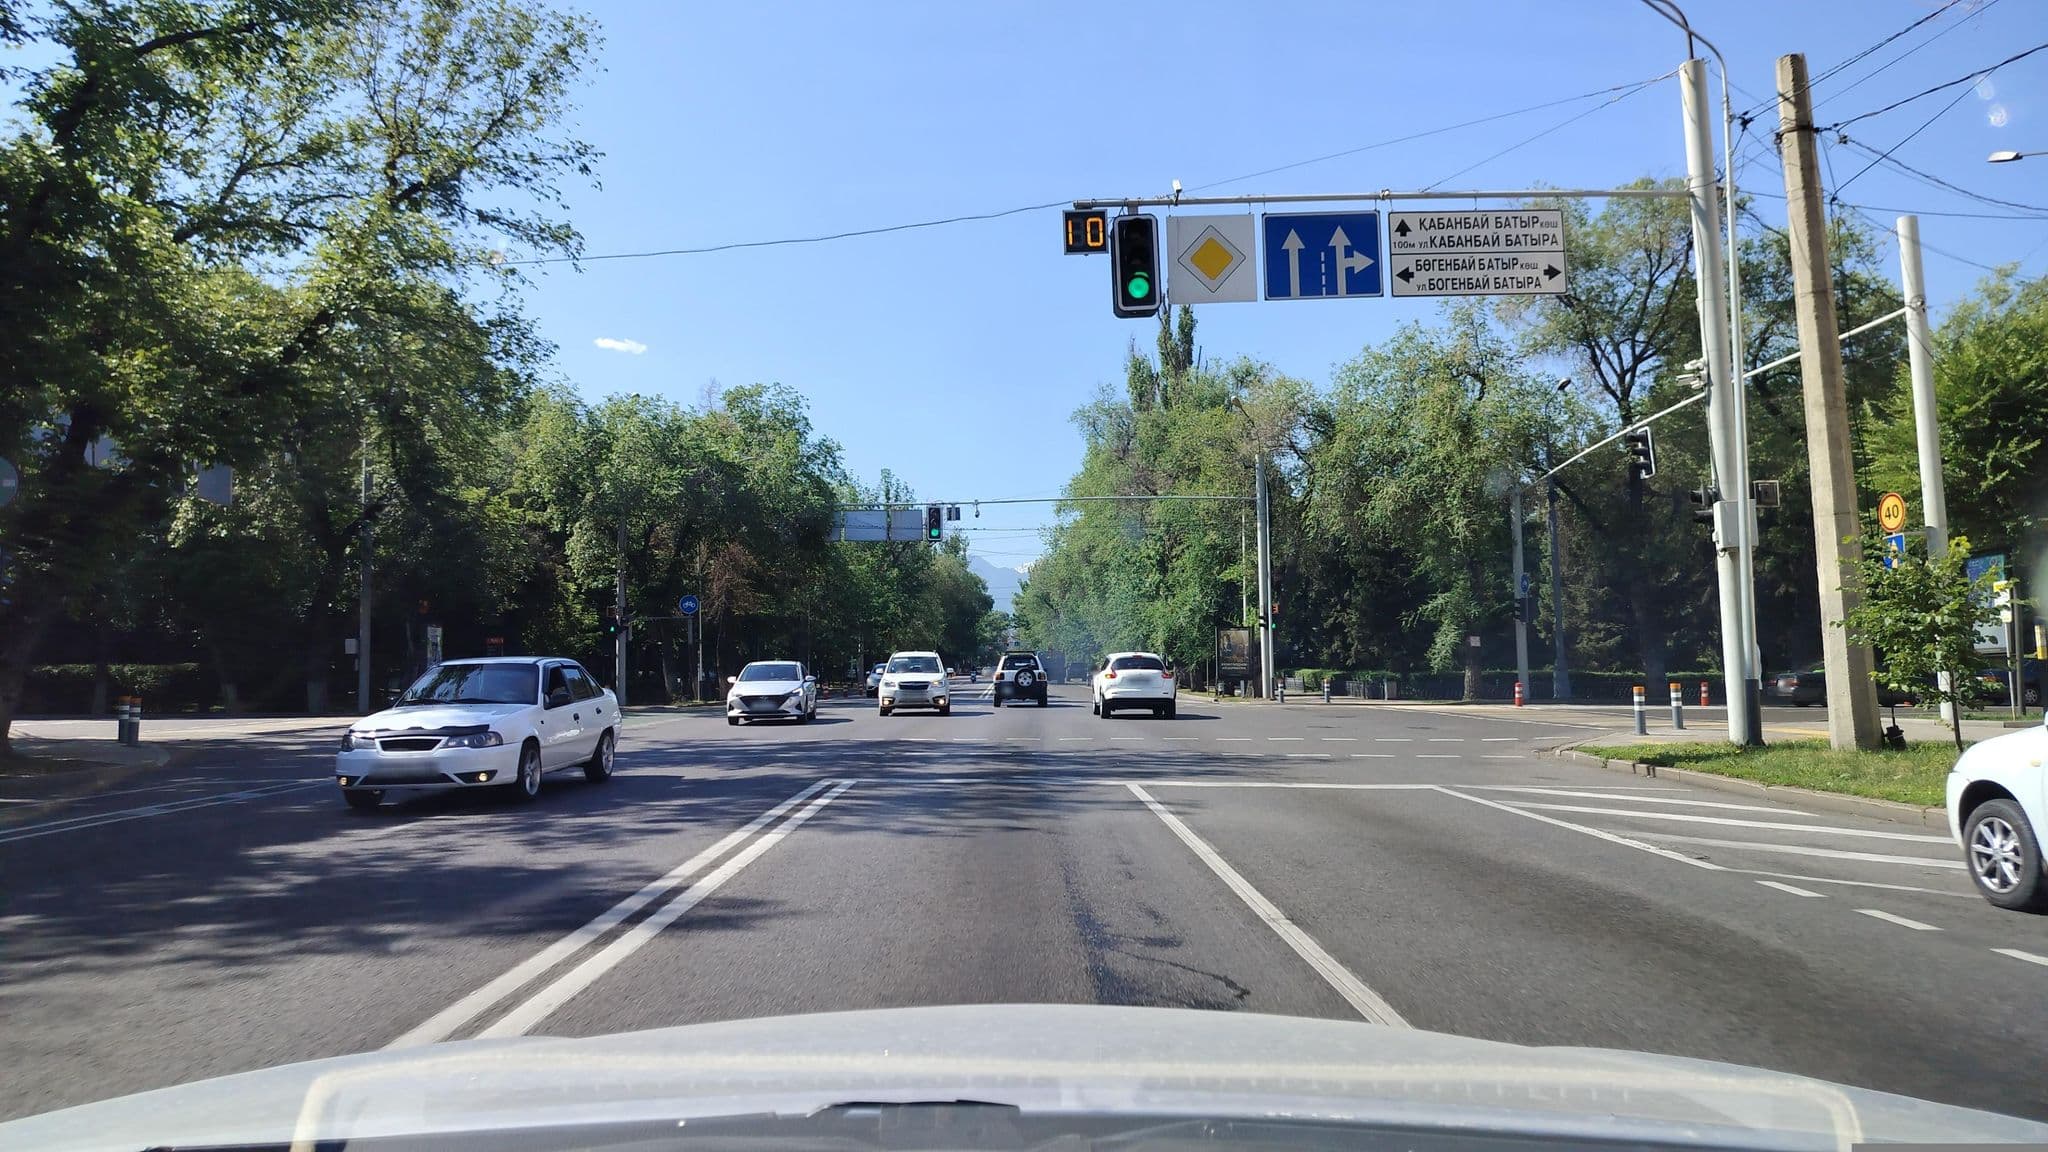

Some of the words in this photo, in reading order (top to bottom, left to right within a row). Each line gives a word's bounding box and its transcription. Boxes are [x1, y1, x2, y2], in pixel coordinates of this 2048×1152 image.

[1419, 214, 1489, 232] ҚАБАНБАЙ
[1494, 216, 1539, 229] БАТЫР
[1540, 220, 1558, 228] көш
[1067, 217, 1104, 247] 10
[1429, 232, 1500, 248] КАБАНБАЙ
[1505, 233, 1558, 247] БАТЫРА
[1393, 241, 1415, 249] 100м
[1415, 255, 1476, 272] БӨГЕНБАЙ
[1478, 257, 1519, 271] БАТЫР
[1519, 262, 1538, 270] көш
[1428, 274, 1490, 291] БОГЕНБАЙ
[1494, 276, 1542, 290] БАТЫРА
[1885, 504, 1899, 520] 40
